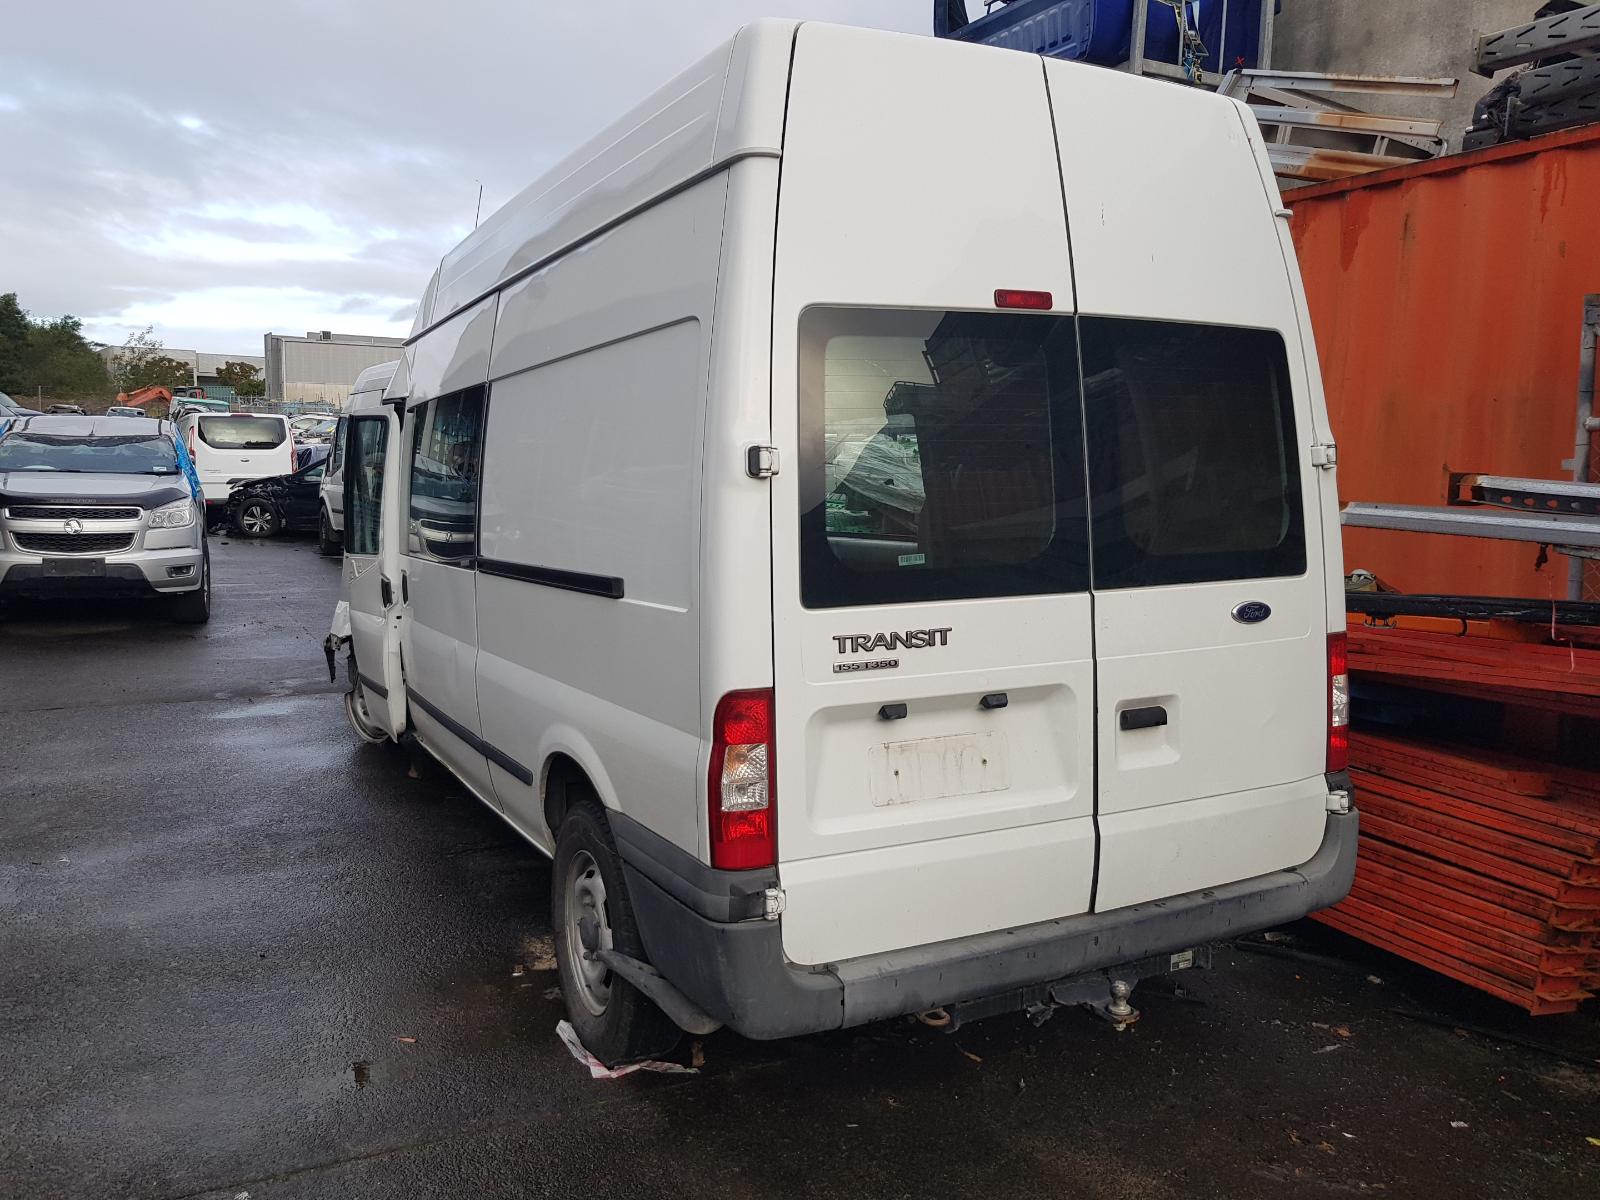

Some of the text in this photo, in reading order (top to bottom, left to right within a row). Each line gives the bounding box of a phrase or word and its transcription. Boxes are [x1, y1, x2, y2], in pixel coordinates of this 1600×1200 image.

[1243, 605, 1265, 619] Ford
[832, 627, 953, 654] TRANSIT
[836, 659, 898, 672] 155 T350
